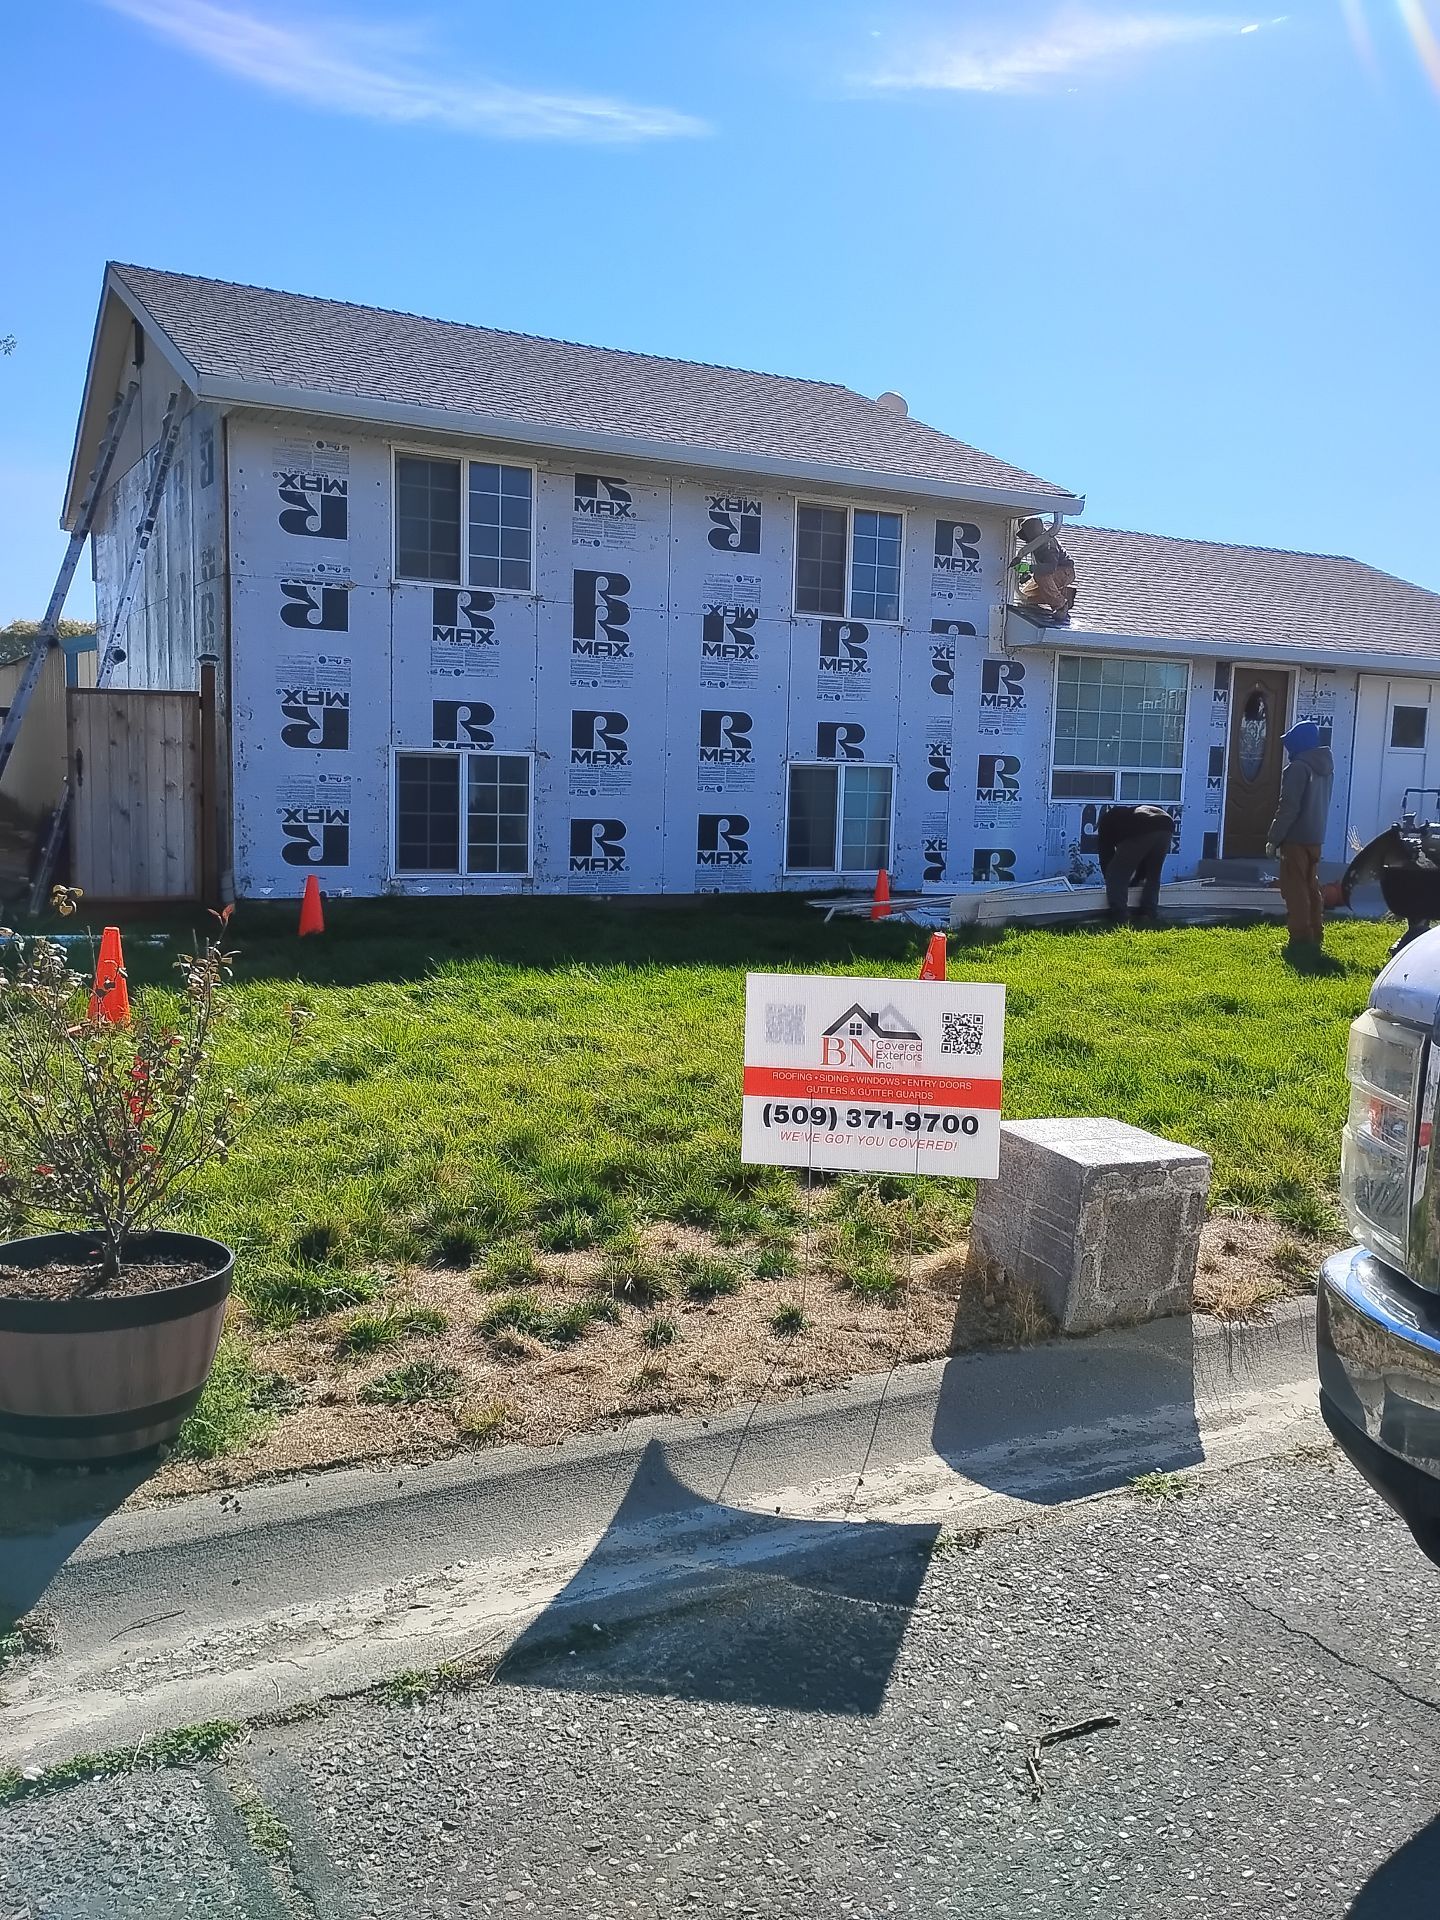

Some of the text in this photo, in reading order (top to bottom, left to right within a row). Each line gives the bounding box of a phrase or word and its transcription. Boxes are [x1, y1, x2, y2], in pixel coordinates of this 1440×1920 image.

[280, 472, 347, 496] MAX
[278, 489, 347, 540] R
[574, 497, 632, 517] MAX
[709, 496, 762, 516] MAX
[707, 511, 761, 554] R
[935, 519, 981, 559] R
[934, 556, 979, 573] MAX
[280, 583, 348, 632] R
[433, 588, 495, 629] R
[433, 626, 495, 645] MAX
[820, 620, 868, 659] R
[572, 638, 629, 657] MAX
[702, 643, 754, 659] MAX
[820, 658, 867, 672] MAX
[982, 659, 1026, 695] R
[282, 689, 349, 707] MAX
[981, 695, 1024, 708] MAX
[281, 705, 349, 750] R
[433, 700, 495, 742] R
[572, 710, 628, 750] R
[700, 710, 753, 749] R
[817, 722, 865, 759] R
[571, 750, 627, 765] MAX
[700, 748, 751, 763] MAX
[977, 755, 1021, 788] R
[977, 790, 1019, 801] MAX
[282, 808, 349, 824] MAX
[570, 819, 627, 857] R
[697, 814, 750, 850] R
[281, 824, 349, 866] R
[570, 857, 625, 871] MAX
[697, 851, 748, 865] MAX
[973, 849, 1016, 881] R
[820, 1037, 875, 1068] BN
[876, 1041, 922, 1051] Covered
[876, 1051, 922, 1061] Exteriors
[876, 1060, 894, 1069] Inc.
[772, 1072, 972, 1090] ROOFING SIDING WINDOWS ENTRY DOORS
[806, 1085, 934, 1100] GUTTERS & GUTTER GUARDS
[763, 1103, 979, 1135] (509) 371-9700
[780, 1131, 957, 1151] WE'VE GOT YOU COVERED!
